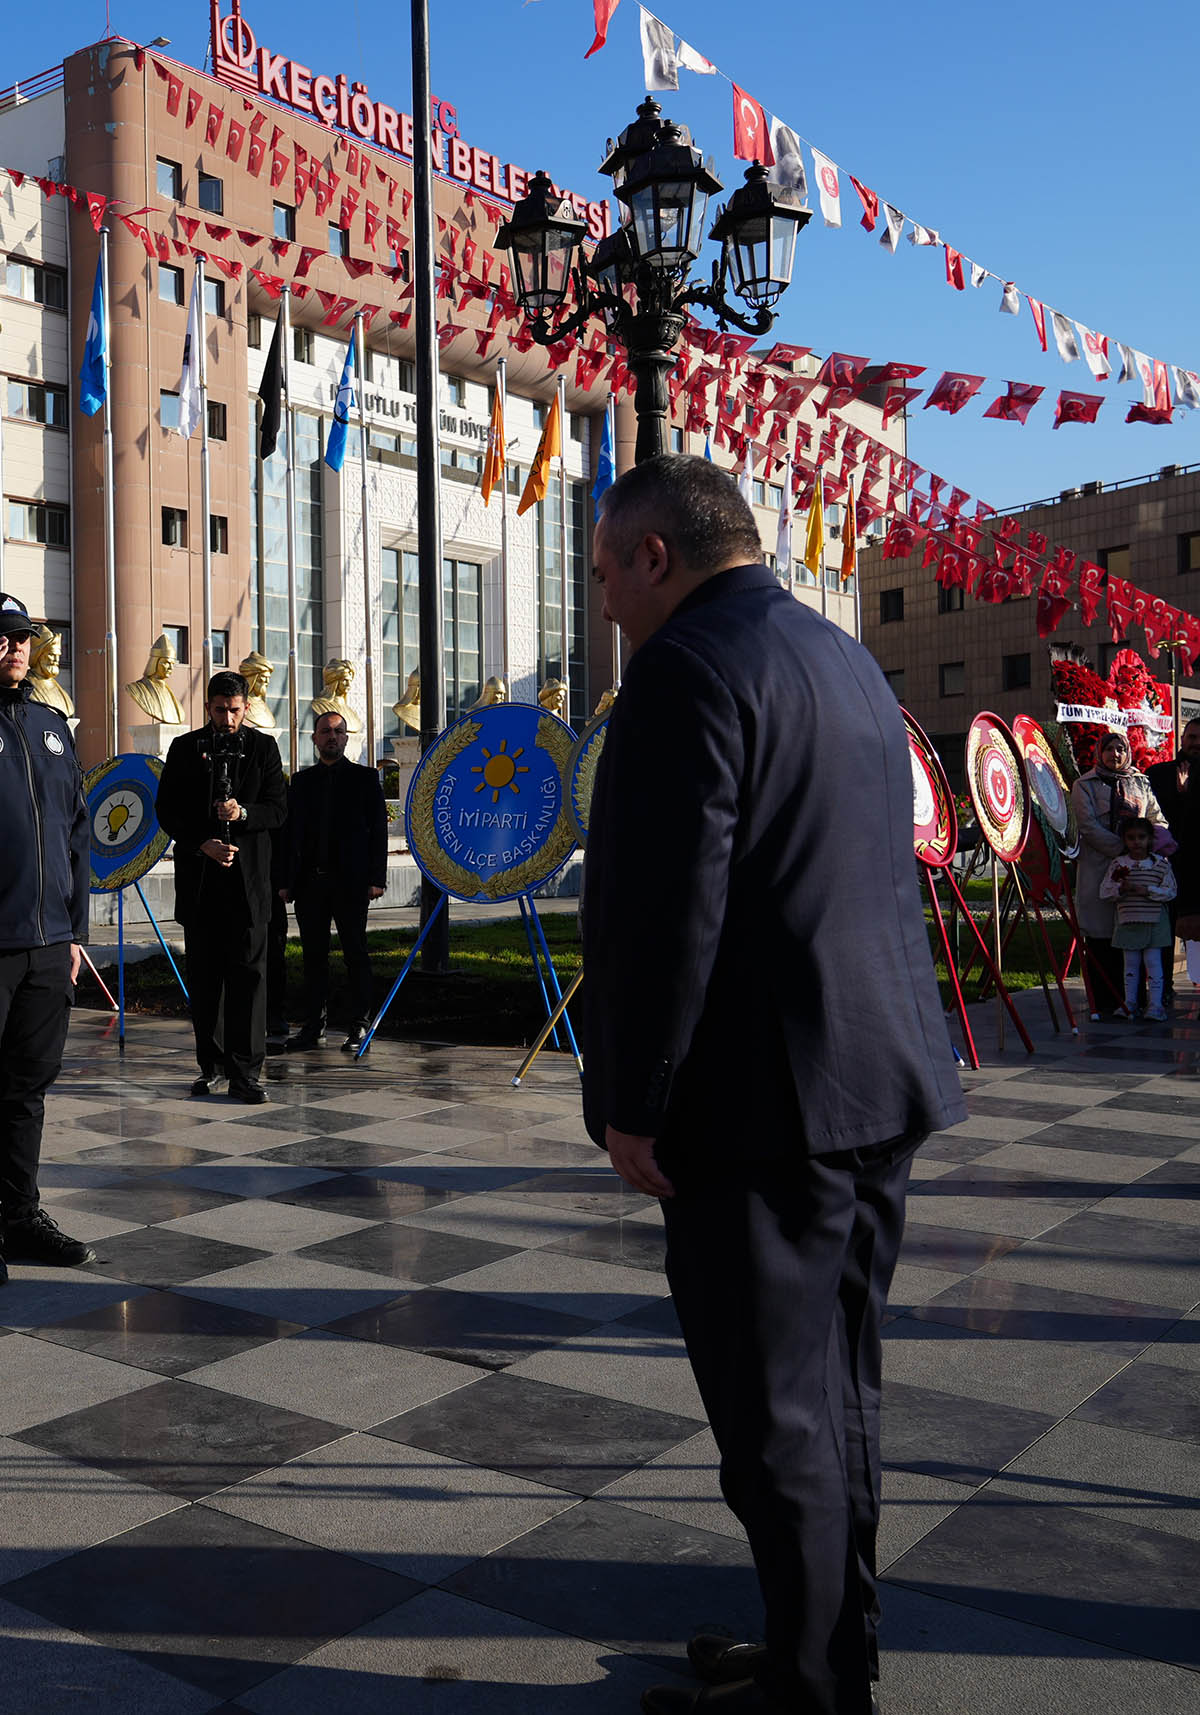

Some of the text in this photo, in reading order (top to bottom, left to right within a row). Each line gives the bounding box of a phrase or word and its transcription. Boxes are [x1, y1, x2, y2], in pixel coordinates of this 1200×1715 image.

[257, 47, 612, 241] KEÇİÖREN BELEESİ
[435, 774, 557, 868] KEÇİÖREN İLÇE BAŞKANLIĞI
